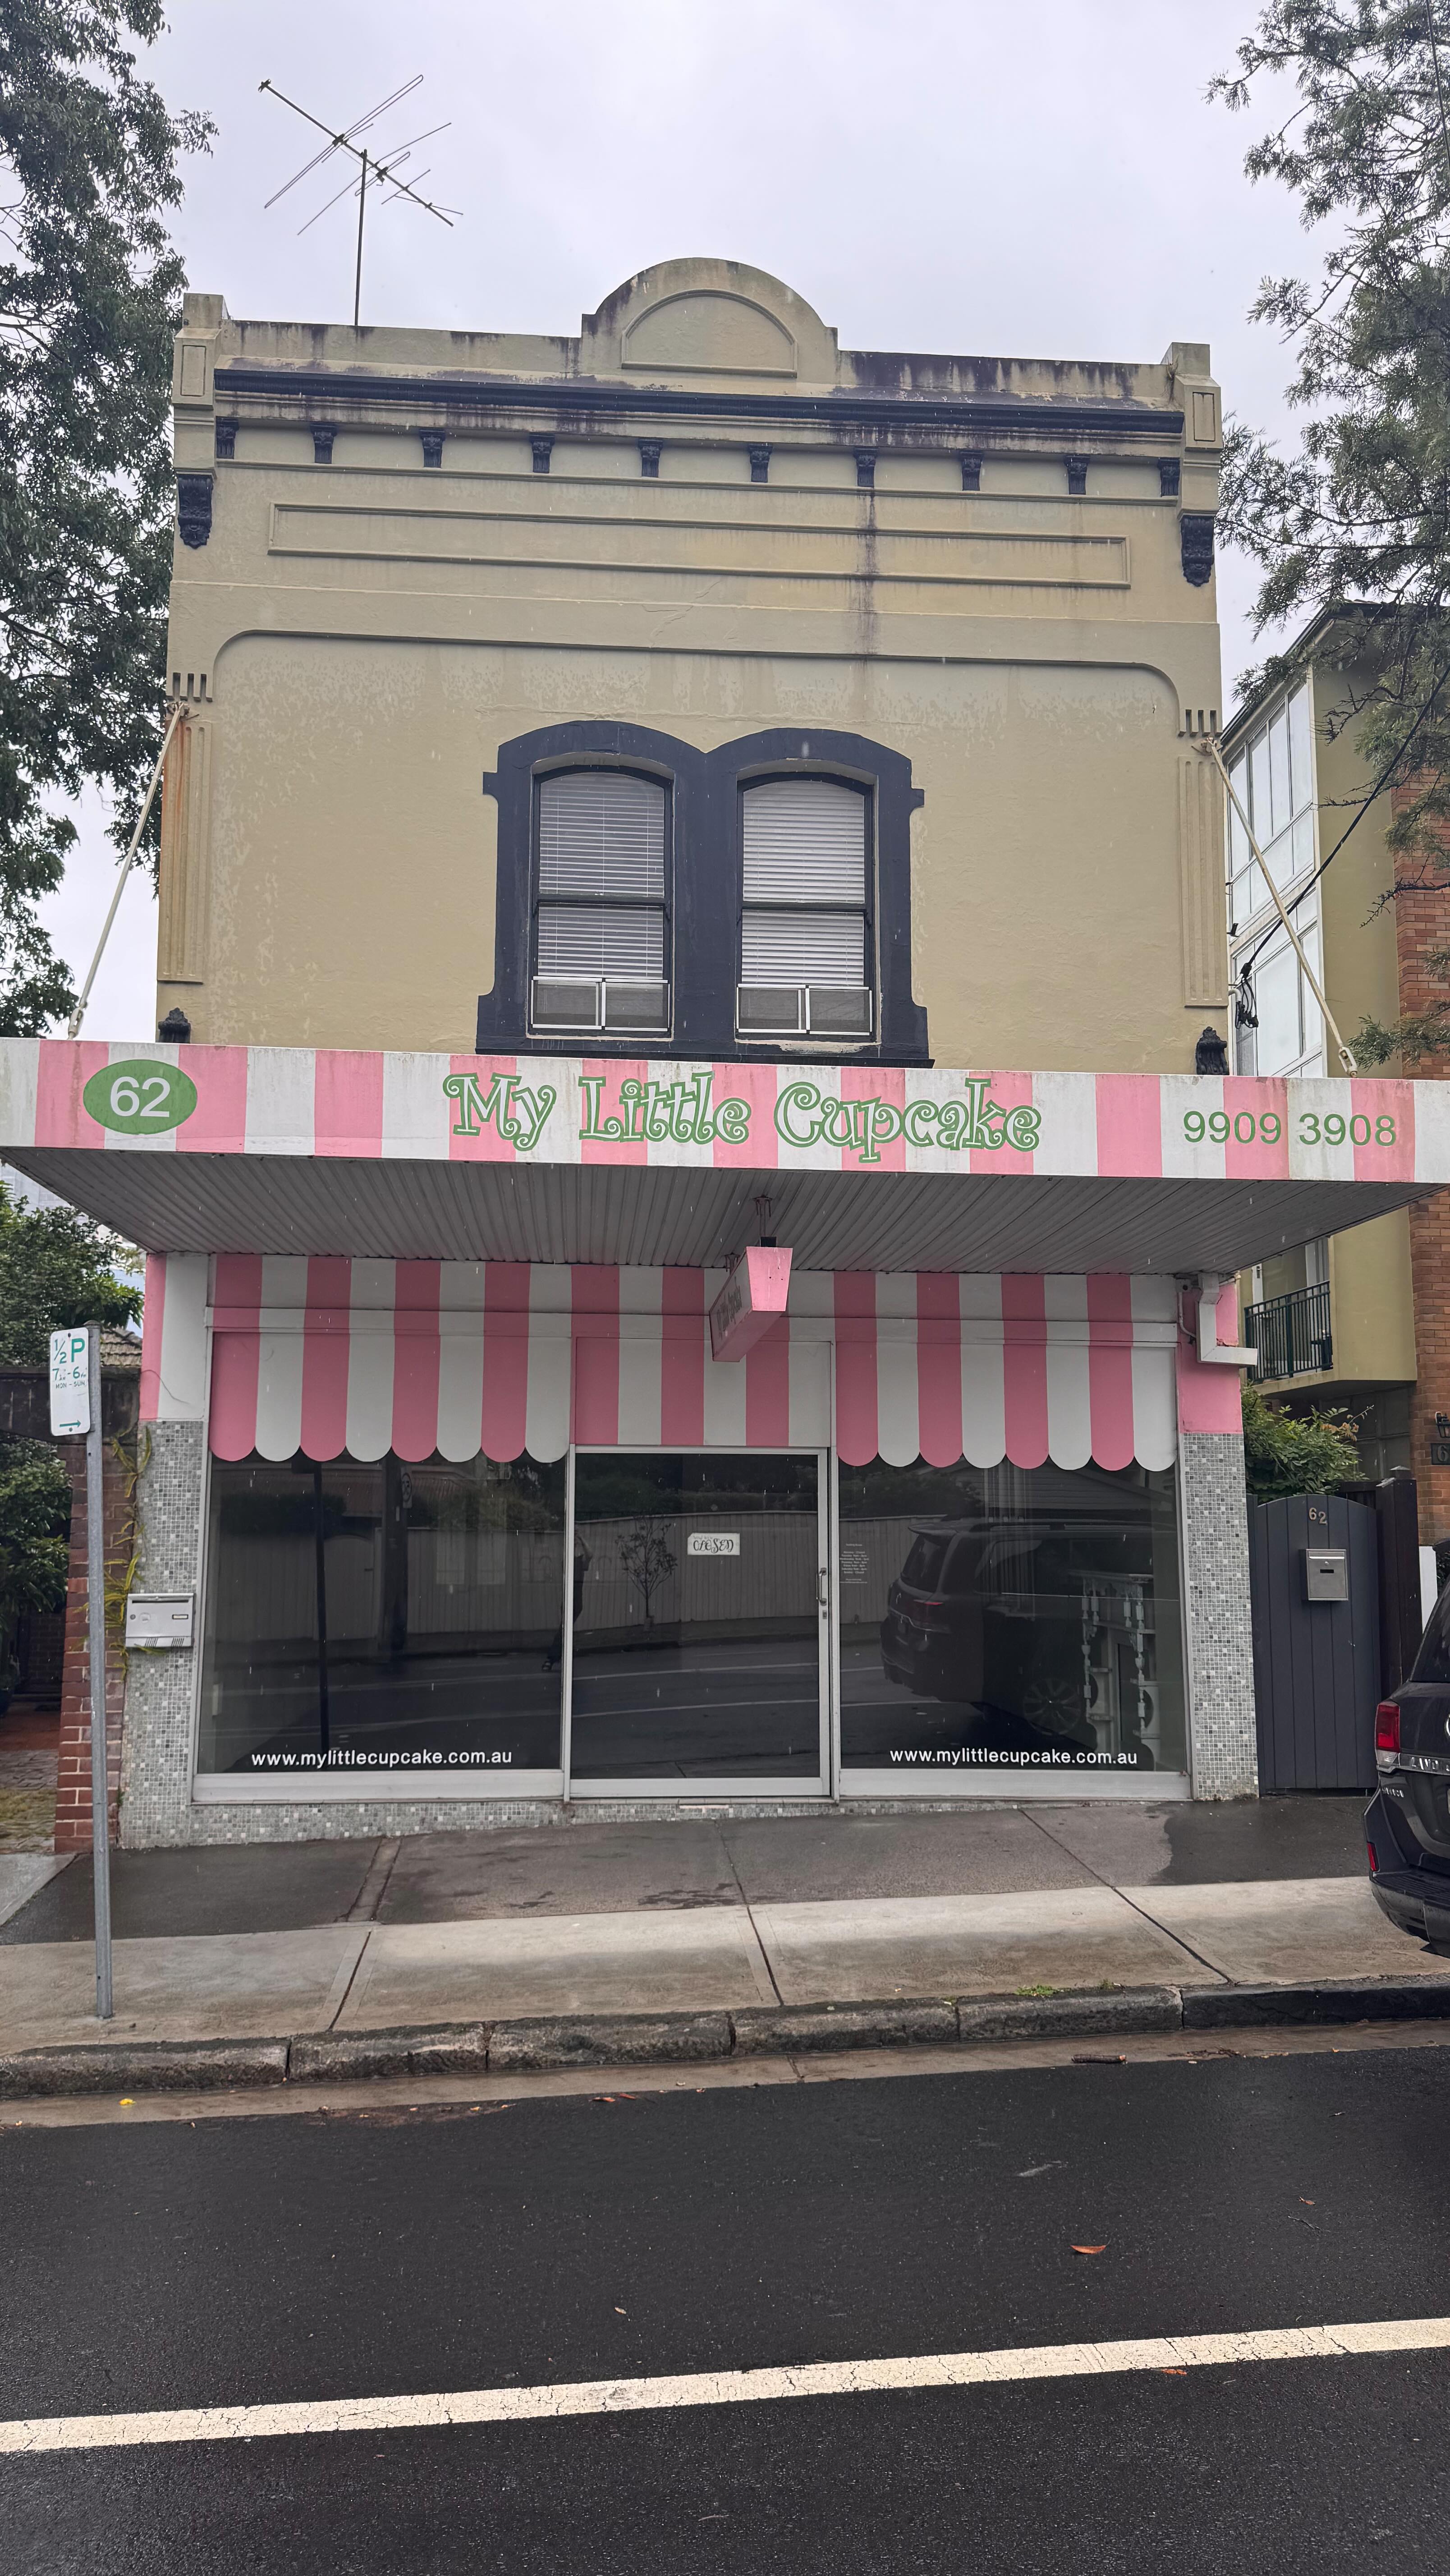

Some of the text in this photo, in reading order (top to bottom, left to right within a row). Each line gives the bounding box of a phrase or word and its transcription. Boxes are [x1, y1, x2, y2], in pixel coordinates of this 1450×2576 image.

[110, 1076, 170, 1118] 62
[442, 1071, 1042, 1164] My Little Cupcake
[1183, 1110, 1397, 1147] 9909 3908
[1308, 1507, 1328, 1525] 62
[693, 1538, 734, 1554] CLOSED
[251, 1749, 512, 1768] www.mylittlecupcake.com.au
[890, 1748, 1138, 1766] www.mylittlecupcake.com.au
